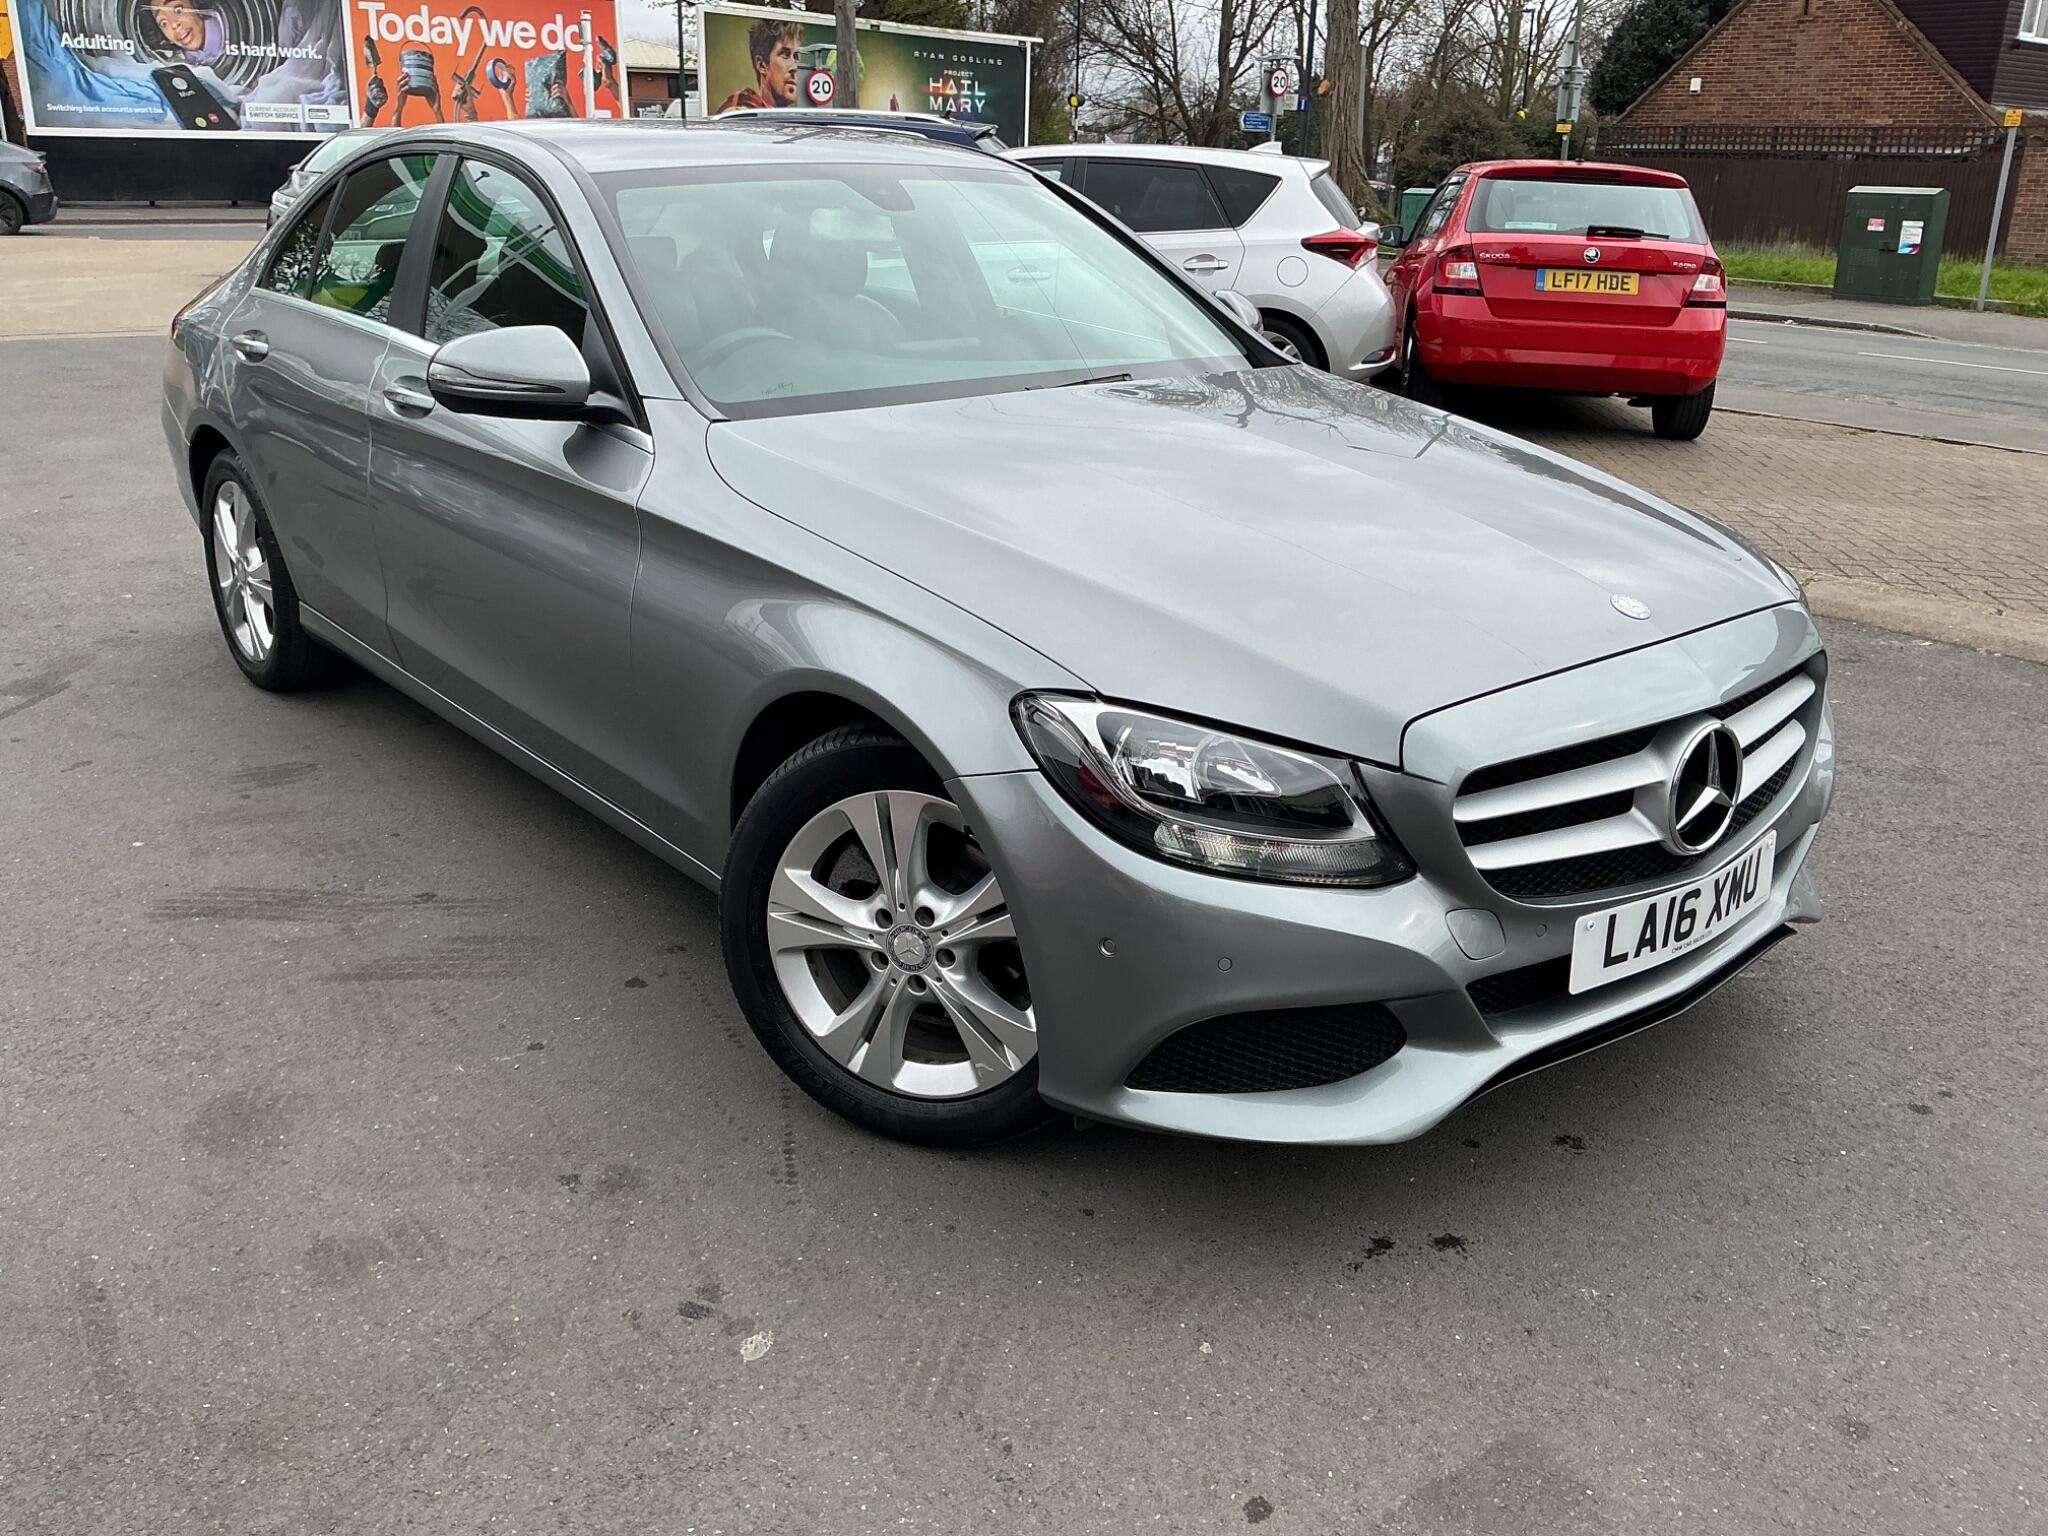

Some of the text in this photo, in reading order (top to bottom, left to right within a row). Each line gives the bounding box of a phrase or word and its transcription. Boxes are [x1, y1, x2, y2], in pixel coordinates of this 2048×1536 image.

[358, 1, 473, 56] Today
[479, 18, 536, 49] we
[61, 32, 322, 59] Adulting is hard work.
[913, 51, 1003, 66] RYAN GOSLING
[943, 69, 974, 77] PROJECT
[1273, 76, 1286, 88] 20
[811, 80, 831, 94] 20
[929, 77, 986, 96] HAIL
[46, 103, 82, 114] Switching
[929, 95, 986, 113] MARY
[1552, 272, 1631, 291] LF17 HDE
[1603, 847, 1763, 969] LA16 XMU
